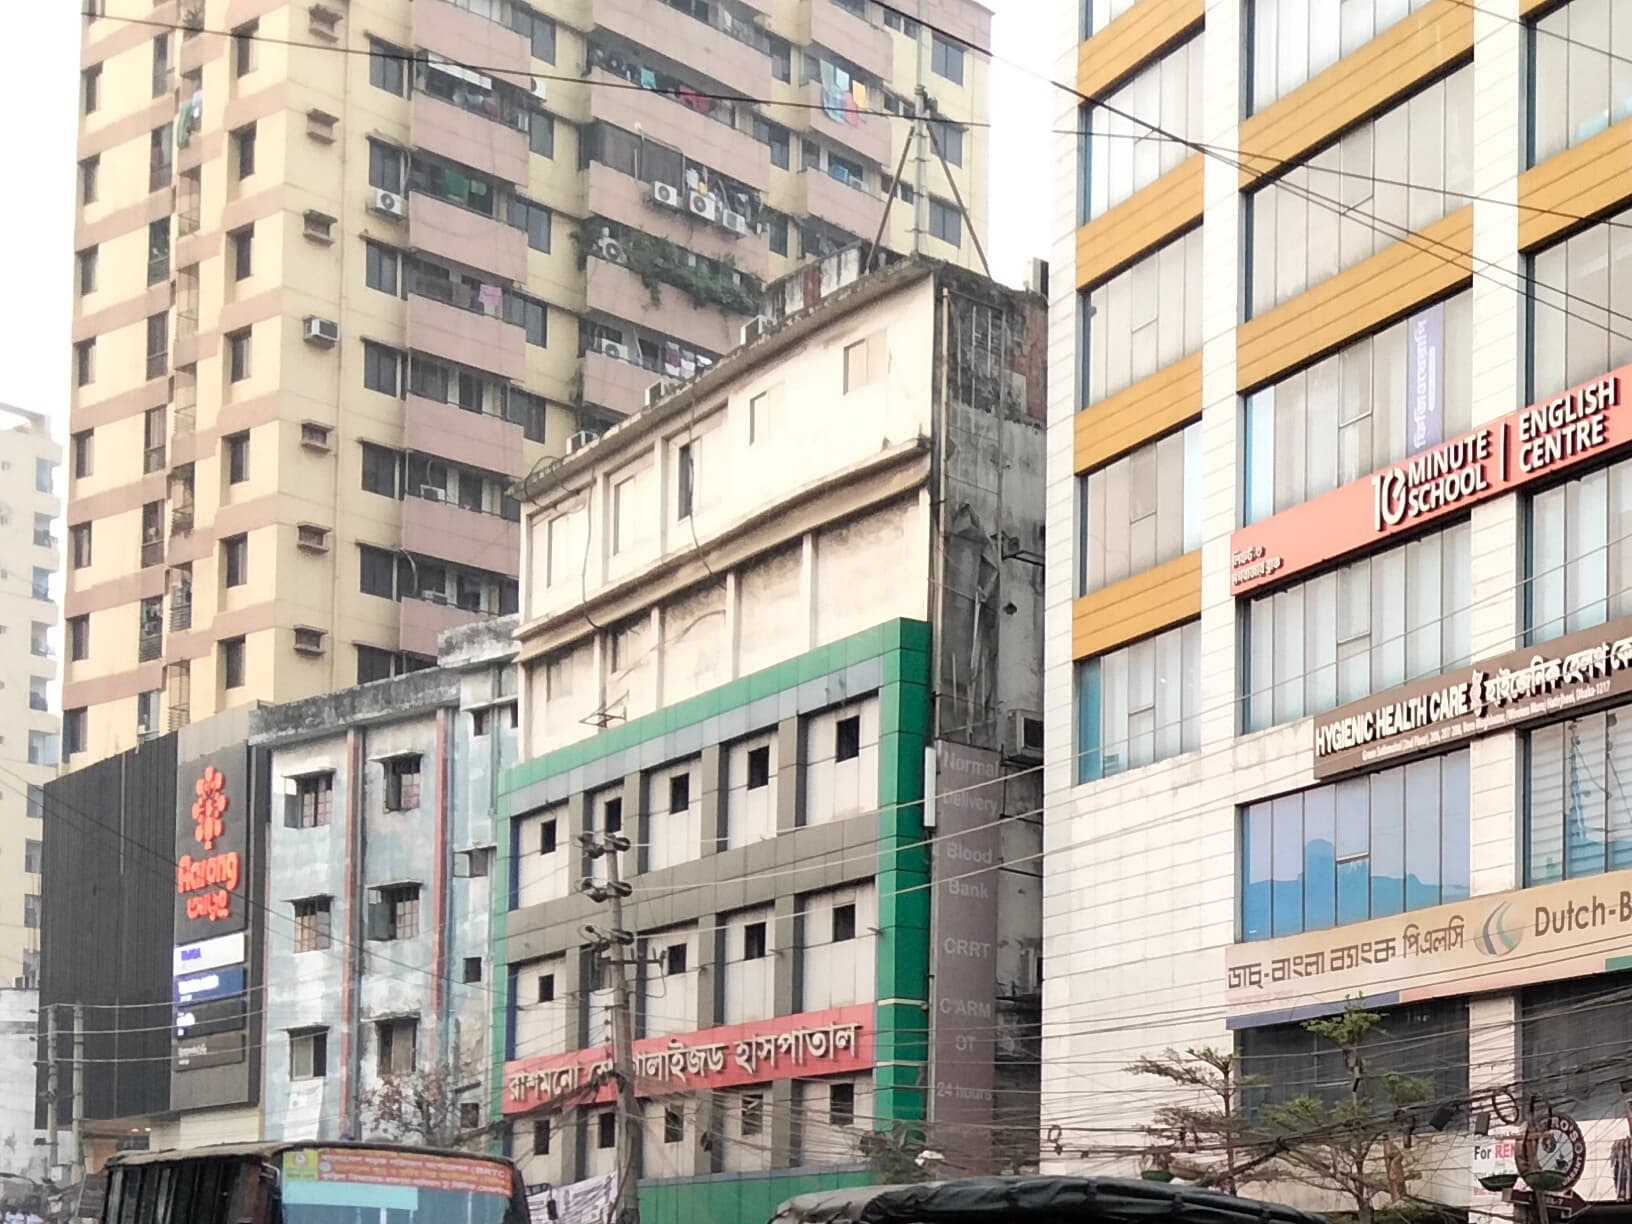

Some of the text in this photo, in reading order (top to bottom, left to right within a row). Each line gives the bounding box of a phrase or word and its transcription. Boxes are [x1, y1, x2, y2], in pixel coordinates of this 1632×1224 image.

[1519, 376, 1617, 442] ENGLISH
[1519, 414, 1605, 473] CENTRE
[1371, 430, 1489, 532] 10 MINUTE
[1407, 463, 1488, 518] SCHOOL
[1483, 656, 1562, 706] হাইজেনিক
[1316, 682, 1469, 756] HYGIENIC HEALTH CARE
[942, 751, 999, 777] Normal
[942, 789, 998, 817] Delivery
[178, 851, 238, 894] Aarong
[946, 842, 993, 864] Blood
[949, 878, 989, 899] Bank
[944, 937, 991, 958] CRRT
[1227, 914, 1465, 990] ডাচ্-বাংলা ব্যাংক পিএলসি
[955, 1001, 991, 1018] ARM
[735, 1022, 863, 1074] হাসপাতাল
[937, 1081, 952, 1097] 24
[1474, 1145, 1492, 1160] For
